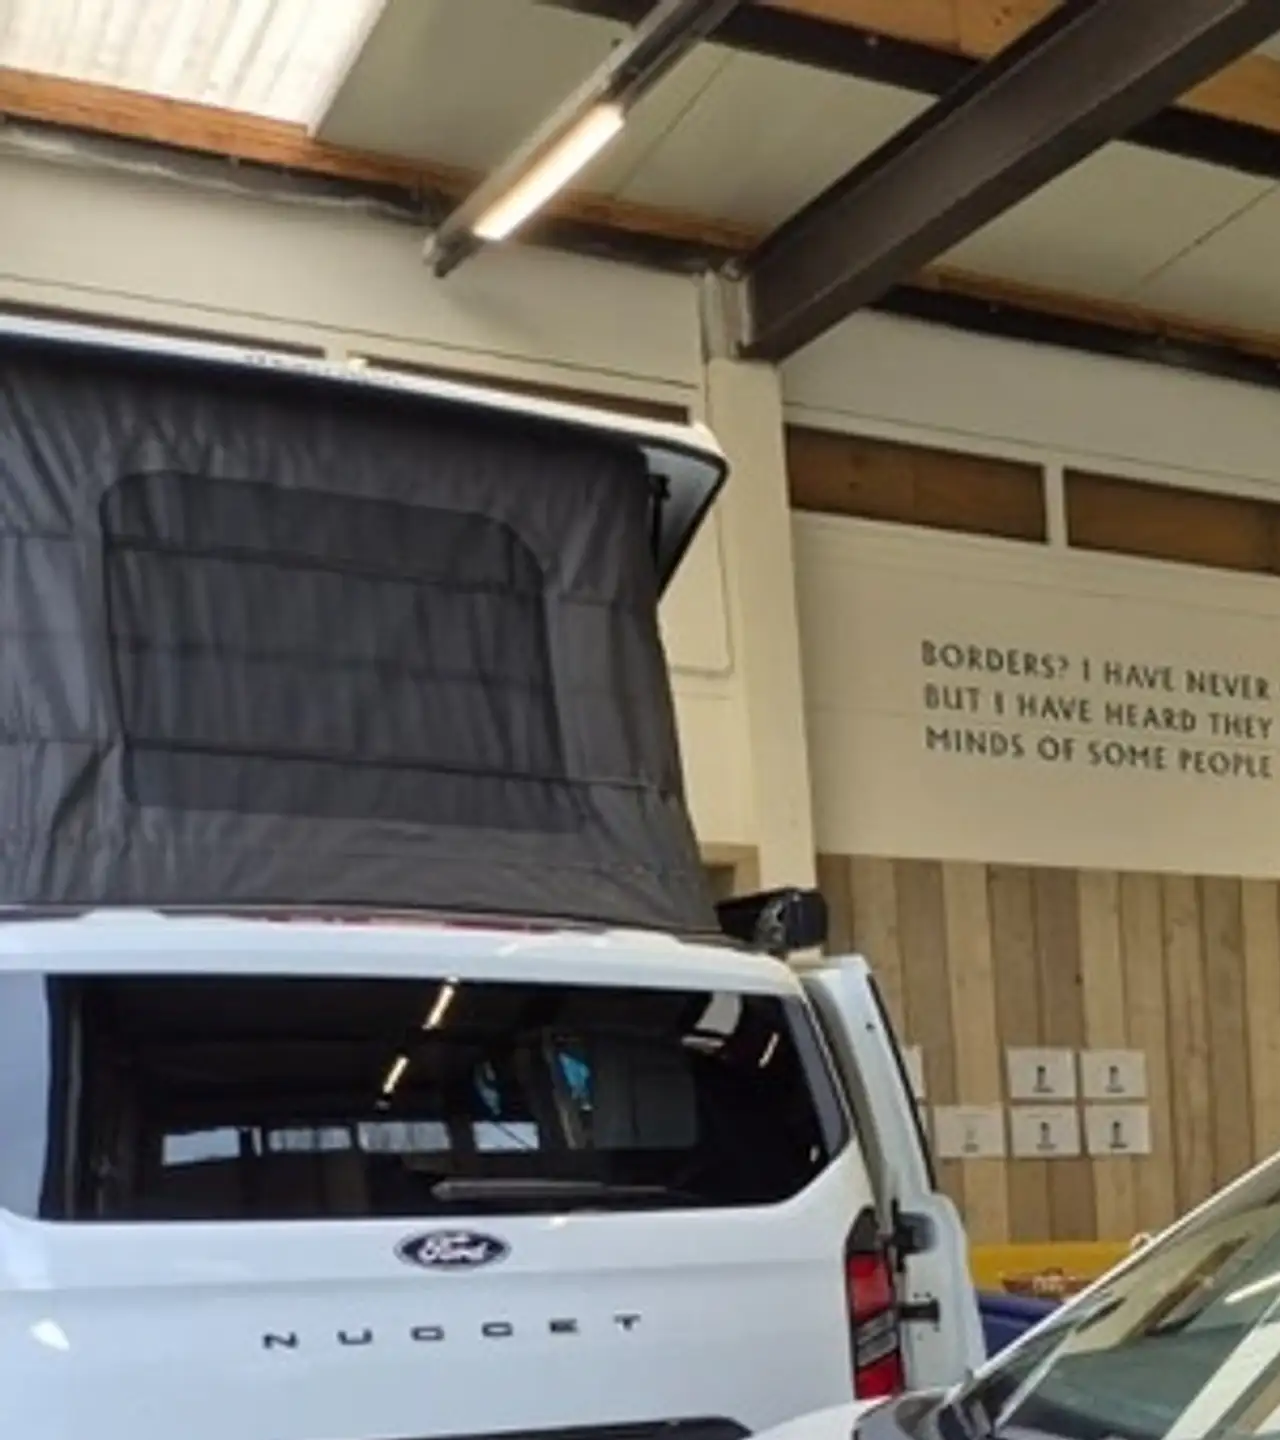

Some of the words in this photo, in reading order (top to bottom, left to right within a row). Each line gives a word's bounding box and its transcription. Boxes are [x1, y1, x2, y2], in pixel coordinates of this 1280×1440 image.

[920, 640, 1070, 680] BORDERS?
[1082, 656, 1091, 683] I
[1104, 661, 1174, 693] HAVE
[1186, 670, 1271, 701] NEVER
[924, 683, 981, 712] BUT
[993, 690, 1004, 715] I
[1016, 692, 1093, 724] HAVE
[1105, 703, 1197, 733] HEARD
[1208, 712, 1273, 740] THEY
[925, 726, 1026, 758] MINDS
[1037, 735, 1077, 762] OF
[1087, 741, 1168, 771] SOME
[1178, 747, 1274, 780] PEOPLE
[262, 1313, 642, 1350] NUGGET
